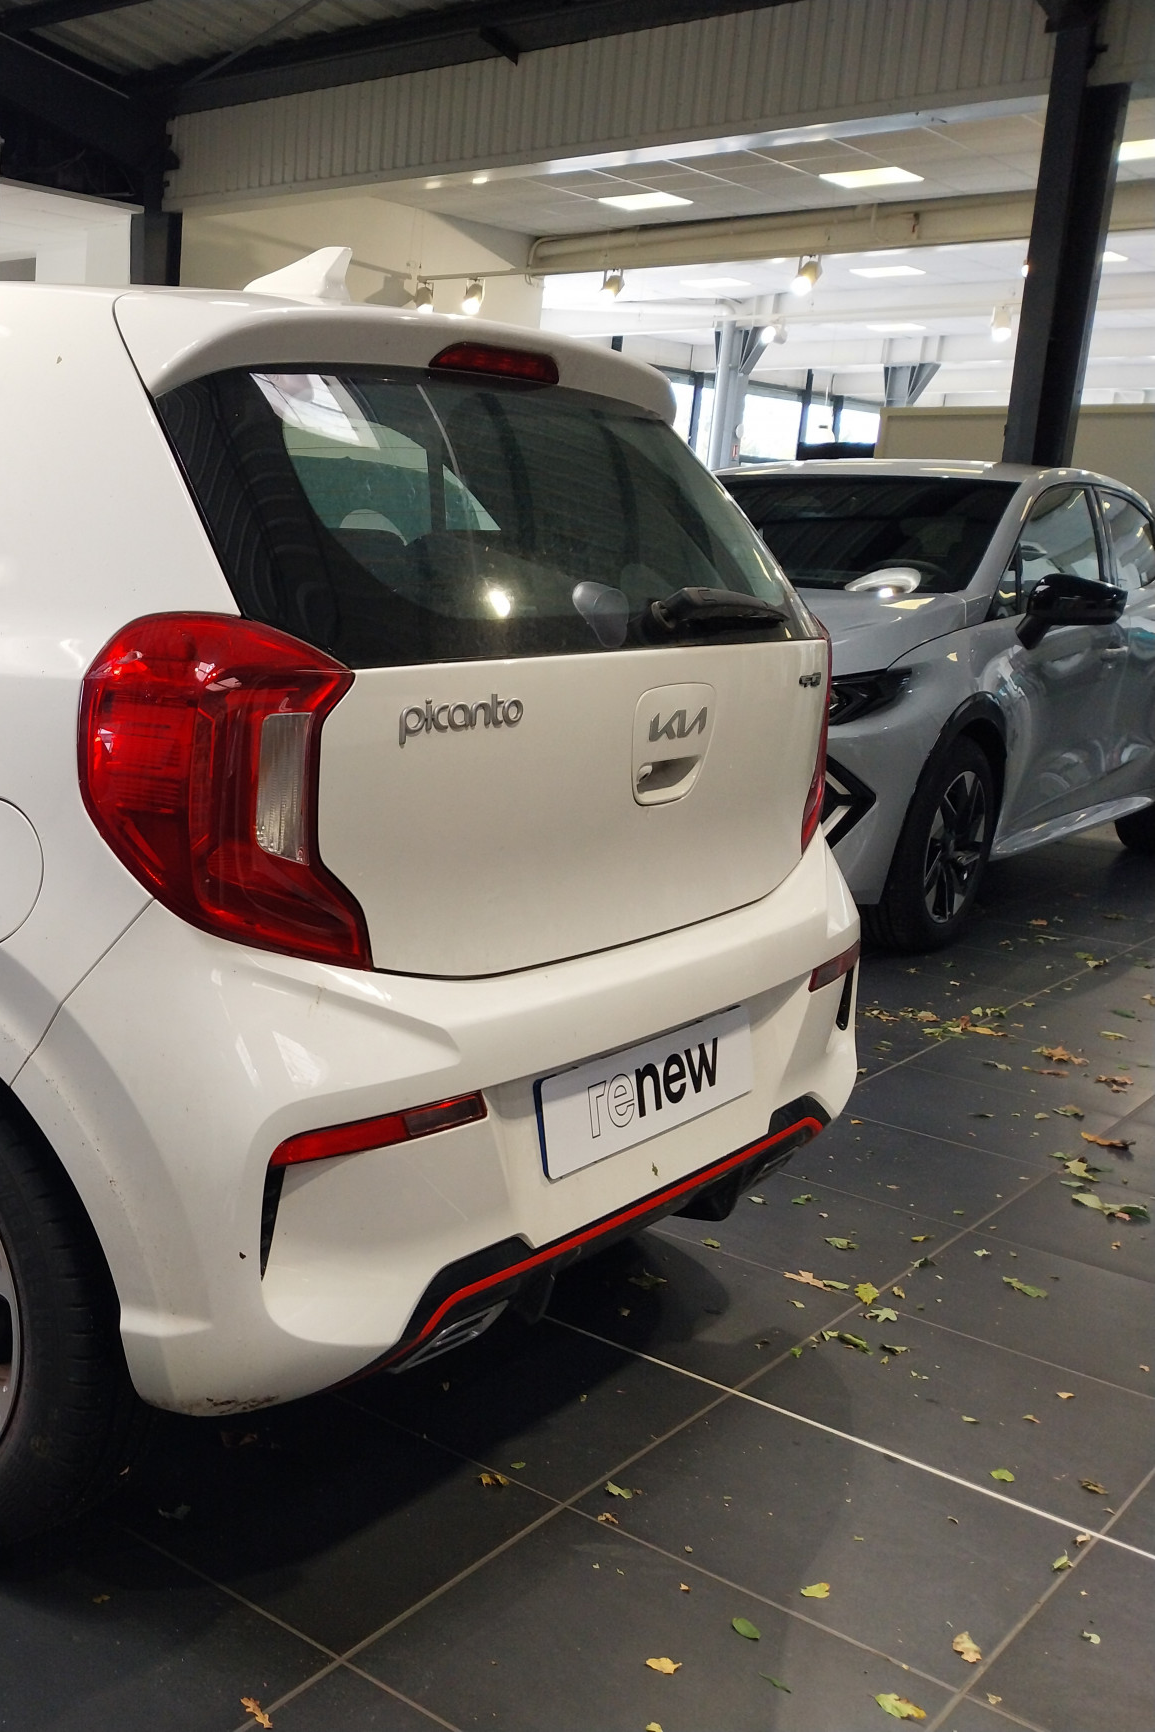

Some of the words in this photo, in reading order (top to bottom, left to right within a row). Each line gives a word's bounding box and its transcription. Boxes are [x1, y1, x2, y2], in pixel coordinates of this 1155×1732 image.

[399, 693, 523, 746] picanto
[649, 707, 708, 742] KIA
[588, 1037, 718, 1138] renew
